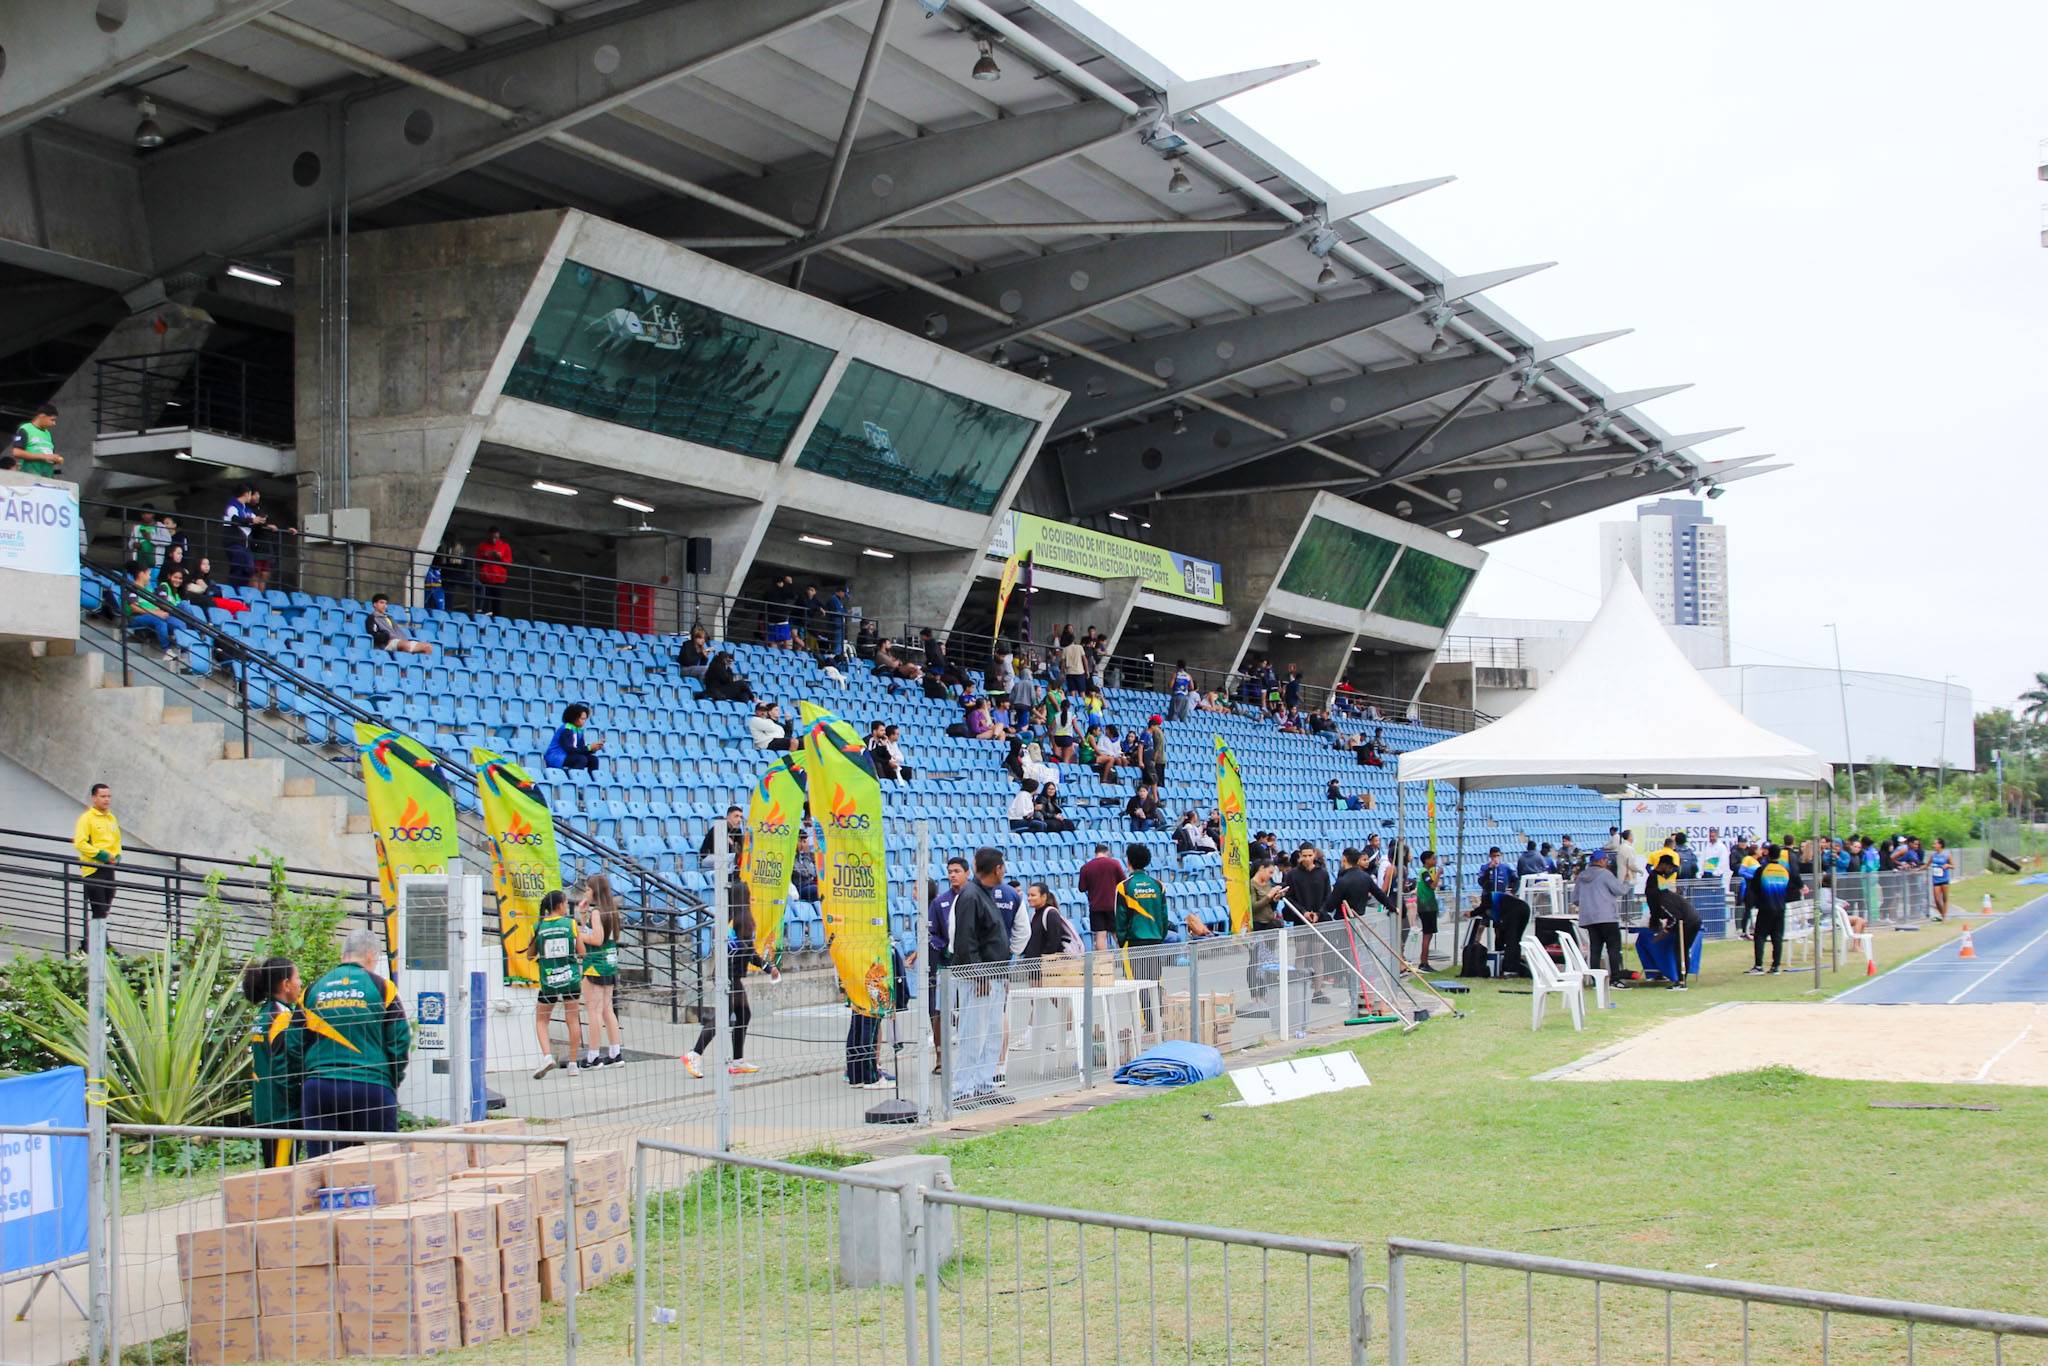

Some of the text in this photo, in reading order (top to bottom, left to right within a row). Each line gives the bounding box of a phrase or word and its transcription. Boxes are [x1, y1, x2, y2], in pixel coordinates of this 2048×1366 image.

[0, 491, 71, 529] ÁRIOS
[1042, 526, 1048, 538] O
[1049, 528, 1085, 548] GOVERNO
[1086, 536, 1094, 551] DE
[1095, 539, 1105, 554] MT
[1107, 542, 1133, 560] REALIZA
[1140, 551, 1161, 568] MAIOR
[1035, 542, 1088, 567] INVESTIMENTO
[1089, 556, 1098, 569] DA
[1141, 568, 1169, 585] ESPORTE
[389, 827, 443, 842] JOGOS
[758, 821, 790, 835] JOGOS
[501, 832, 543, 846] JOGOS
[754, 860, 782, 879] JOGOS
[833, 865, 875, 888] JOGOS
[317, 988, 365, 1000] Seleção
[418, 1037, 445, 1046] Grosso
[419, 1030, 438, 1038] Mato
